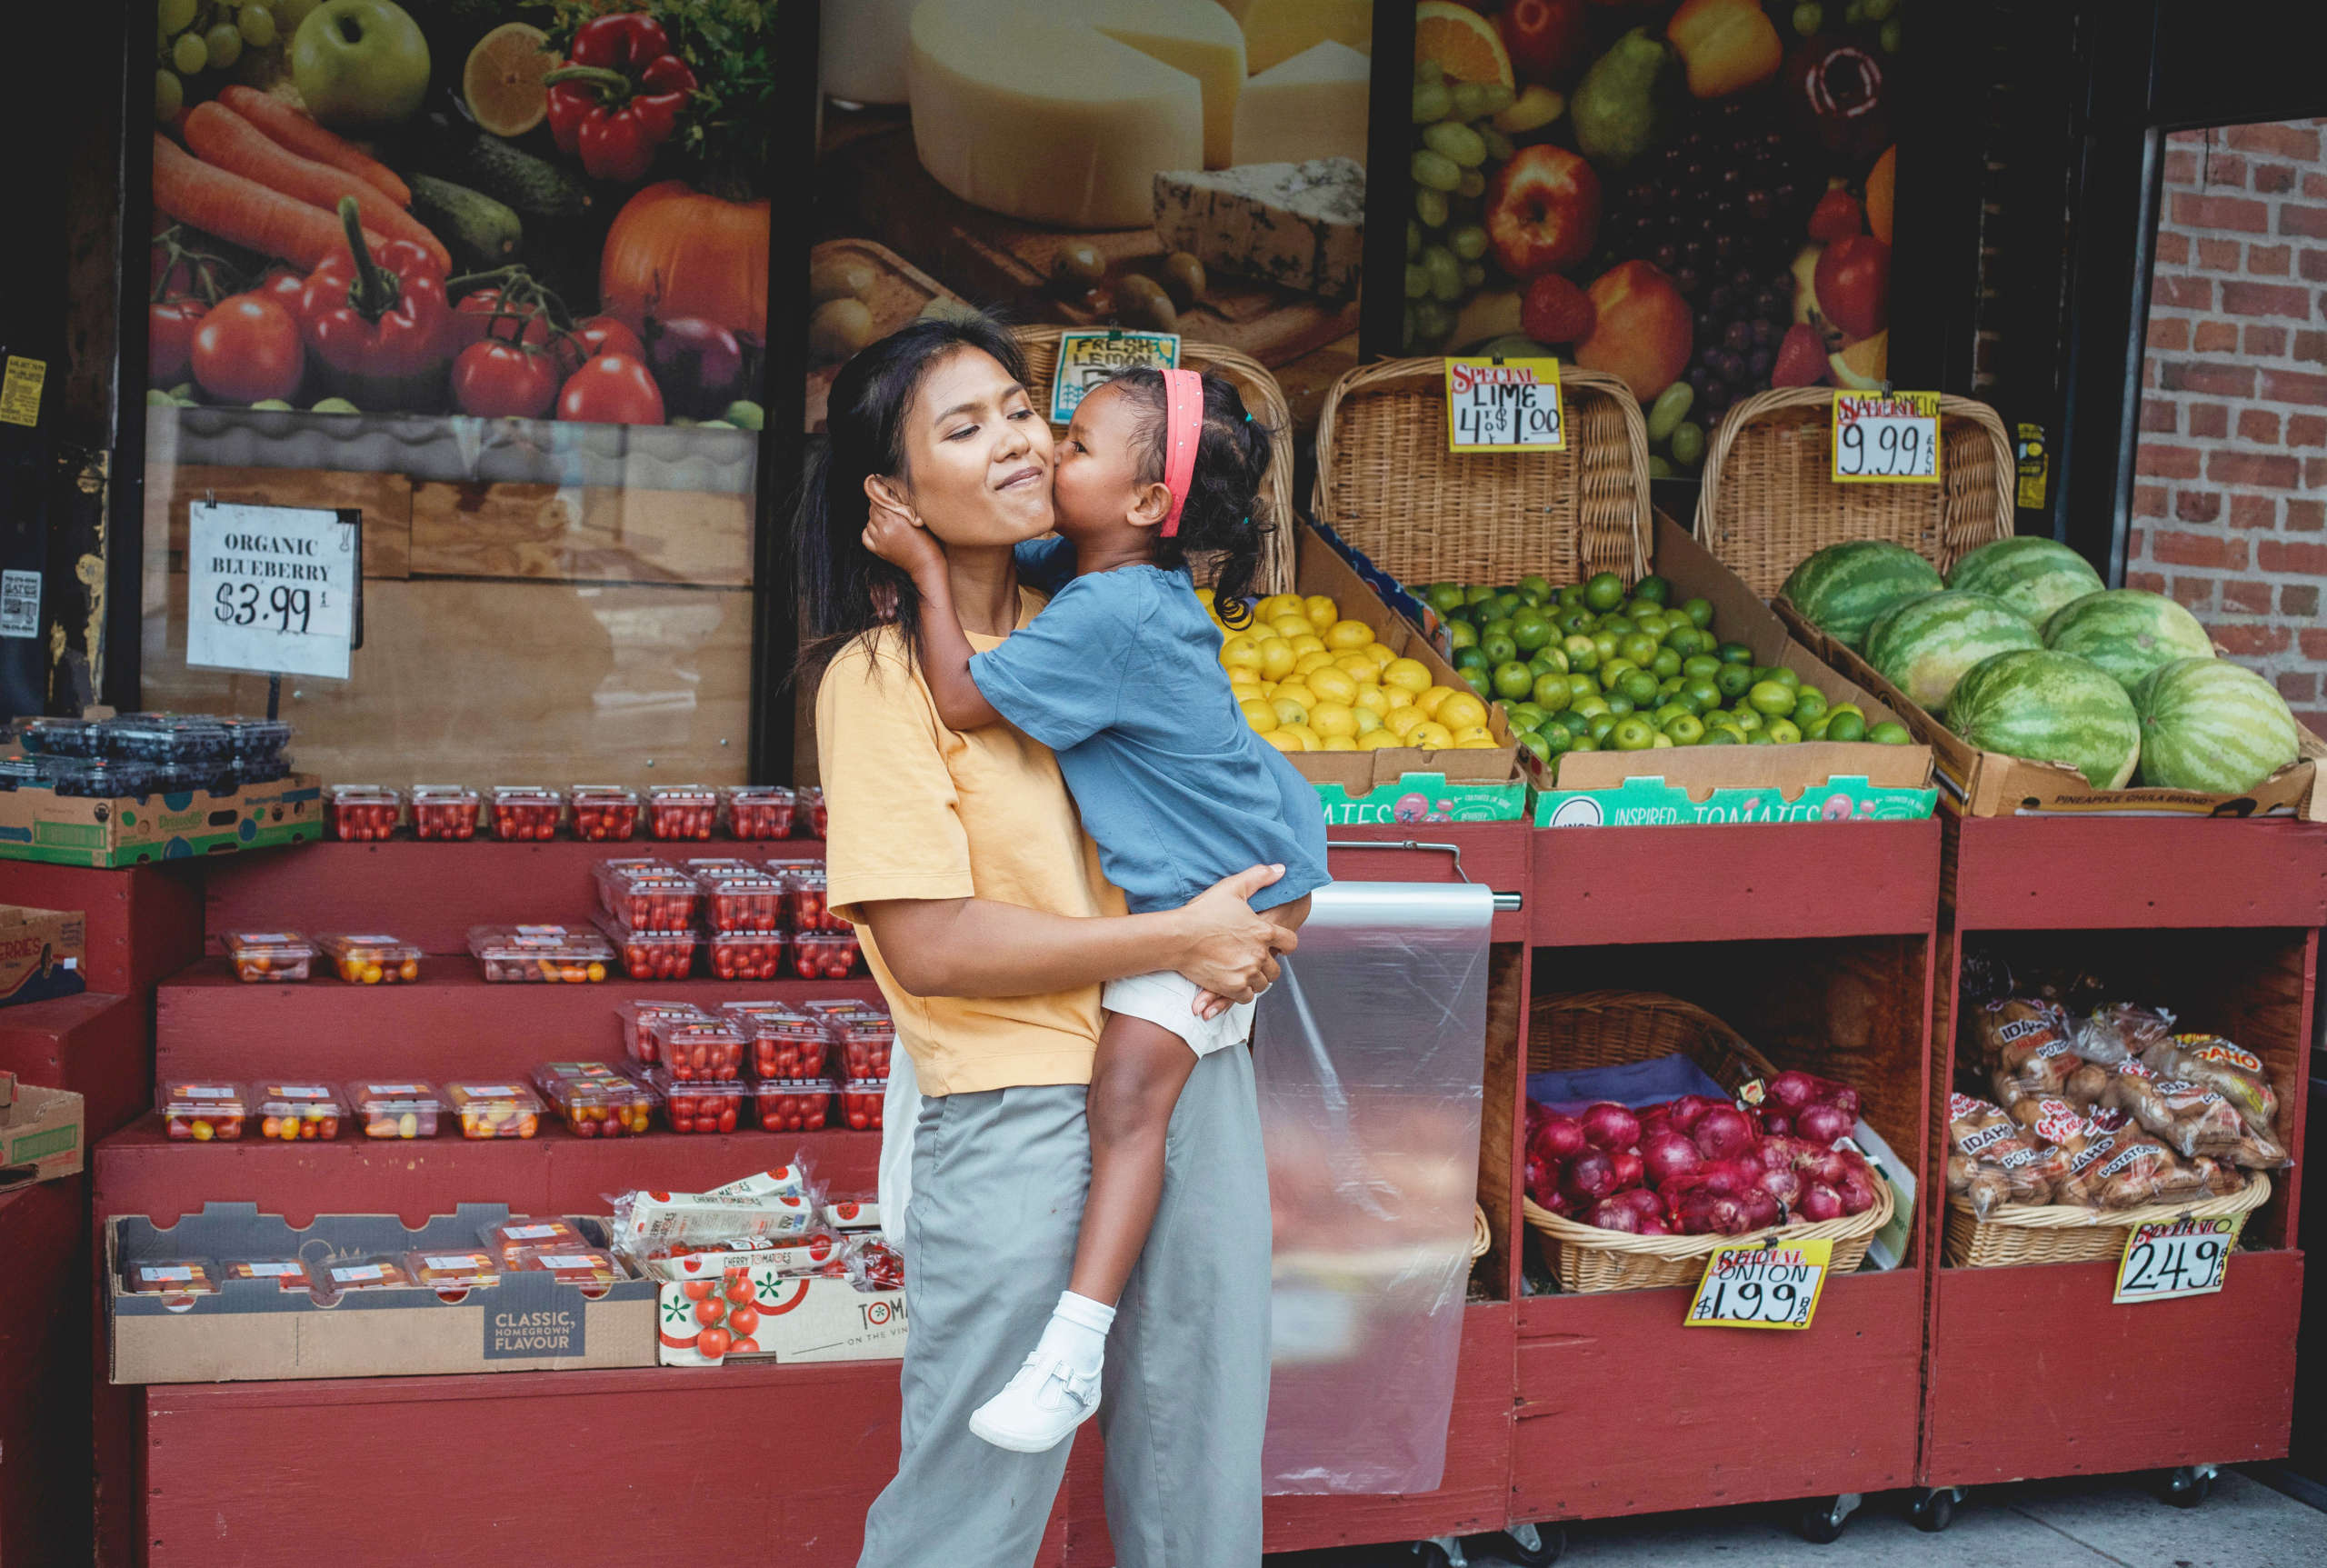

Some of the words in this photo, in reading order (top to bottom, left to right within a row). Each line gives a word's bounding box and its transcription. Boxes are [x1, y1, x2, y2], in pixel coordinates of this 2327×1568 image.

[1077, 338, 1154, 354] FRESH
[1074, 353, 1153, 366] LEMON
[1452, 364, 1539, 394] SPECIAL
[1473, 384, 1537, 408] LIME
[1841, 424, 1919, 475] 9.99
[225, 533, 318, 556] ORGANIC
[212, 557, 330, 582] BLUEBERRY
[215, 582, 310, 634] $3.99
[2055, 794, 2122, 804] PINEAPPLE
[724, 1255, 749, 1268] CHERRY
[751, 1252, 793, 1266] TOMATOES
[2122, 1240, 2220, 1291] 2.49
[1718, 1263, 1809, 1283] ONION
[1696, 1282, 1796, 1323] $1.99
[1793, 1296, 1811, 1328] BAG
[494, 1311, 576, 1329] CLASSIC,
[495, 1326, 571, 1337] HOMEGROWN
[847, 1336, 863, 1345] ON
[867, 1331, 887, 1341] THE
[494, 1336, 571, 1352] FLAVOUR
